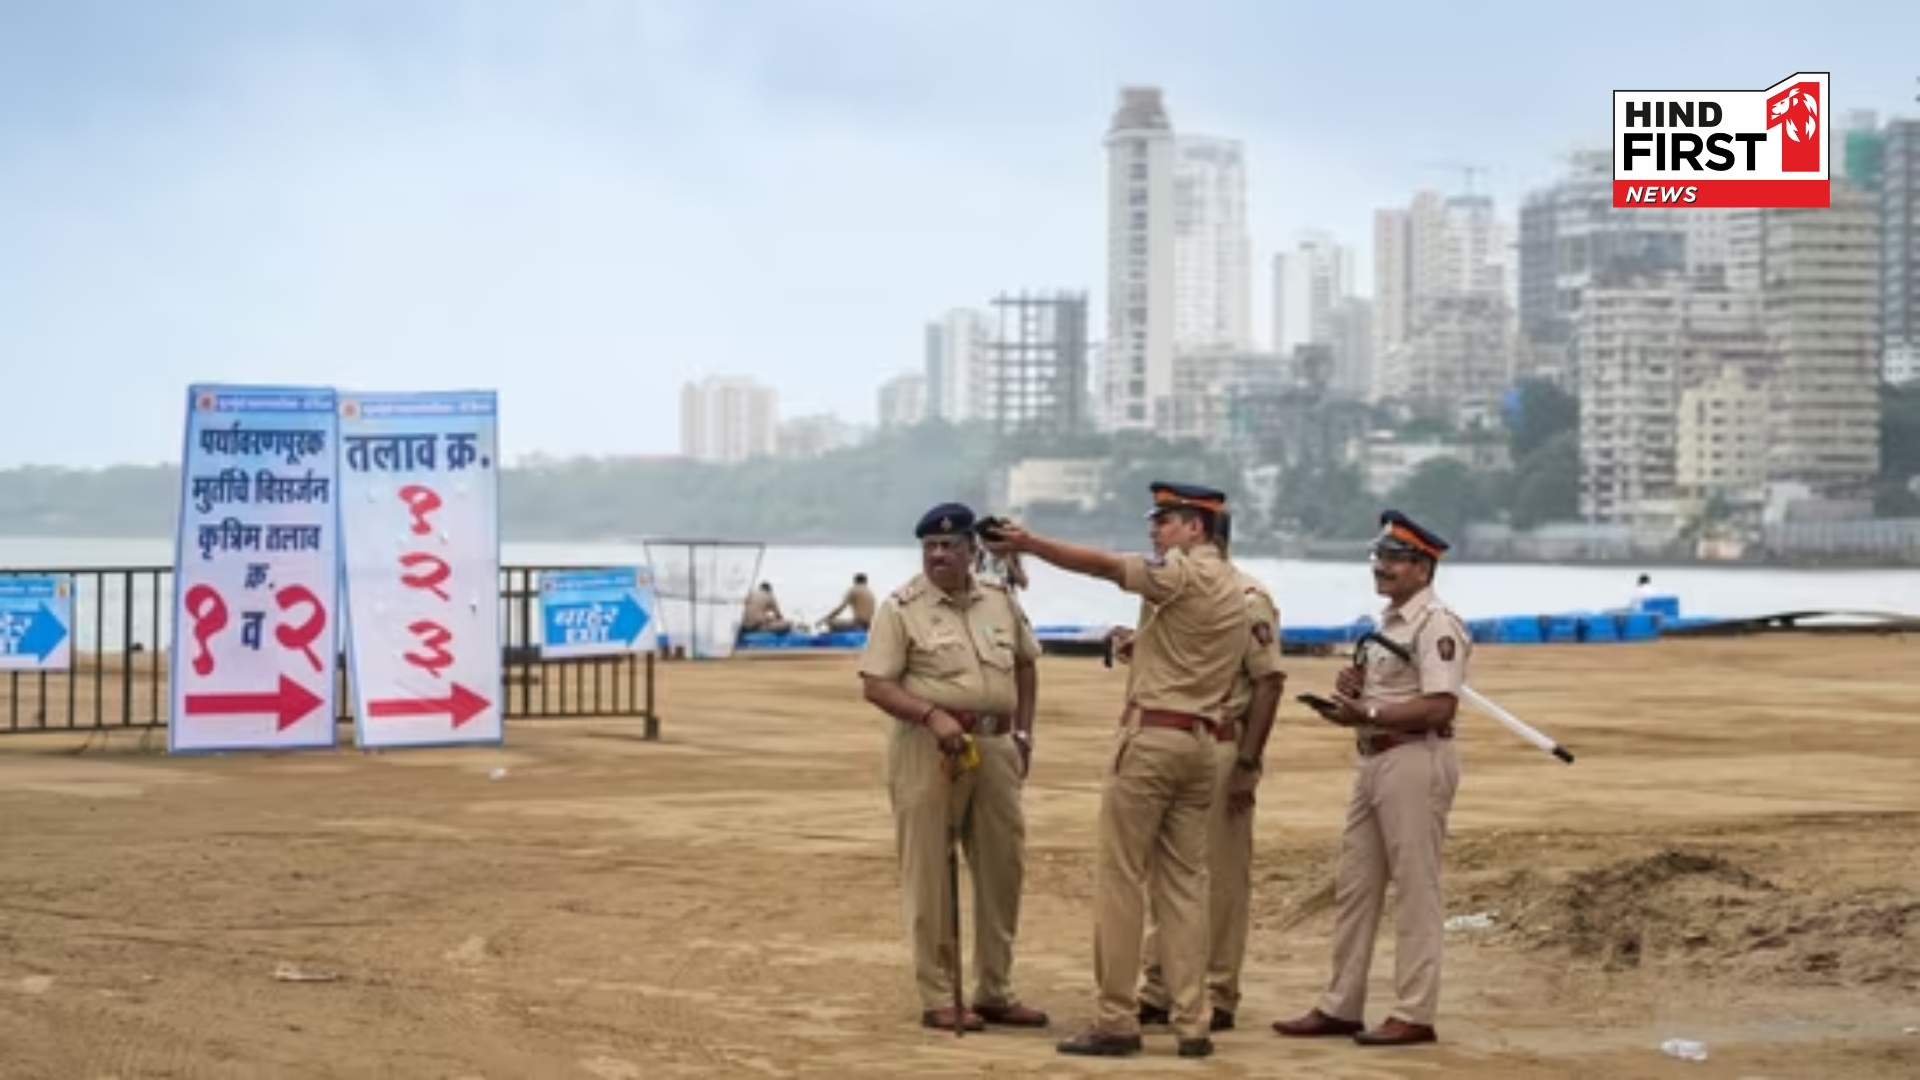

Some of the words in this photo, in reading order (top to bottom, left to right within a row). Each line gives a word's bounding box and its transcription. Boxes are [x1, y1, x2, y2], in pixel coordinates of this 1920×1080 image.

[199, 419, 325, 466] पर्यावरणपूरक
[344, 433, 437, 472] तलाव
[445, 432, 490, 470] क्र.
[255, 467, 329, 504] विसर्जन
[398, 484, 442, 535] १
[198, 516, 262, 561] कृत्रिम
[265, 523, 322, 551] तलाव
[244, 562, 275, 590] क्र.
[399, 552, 451, 602] २
[185, 583, 229, 677] १
[241, 610, 266, 651] व
[275, 583, 326, 673] २
[404, 620, 455, 679] ३
